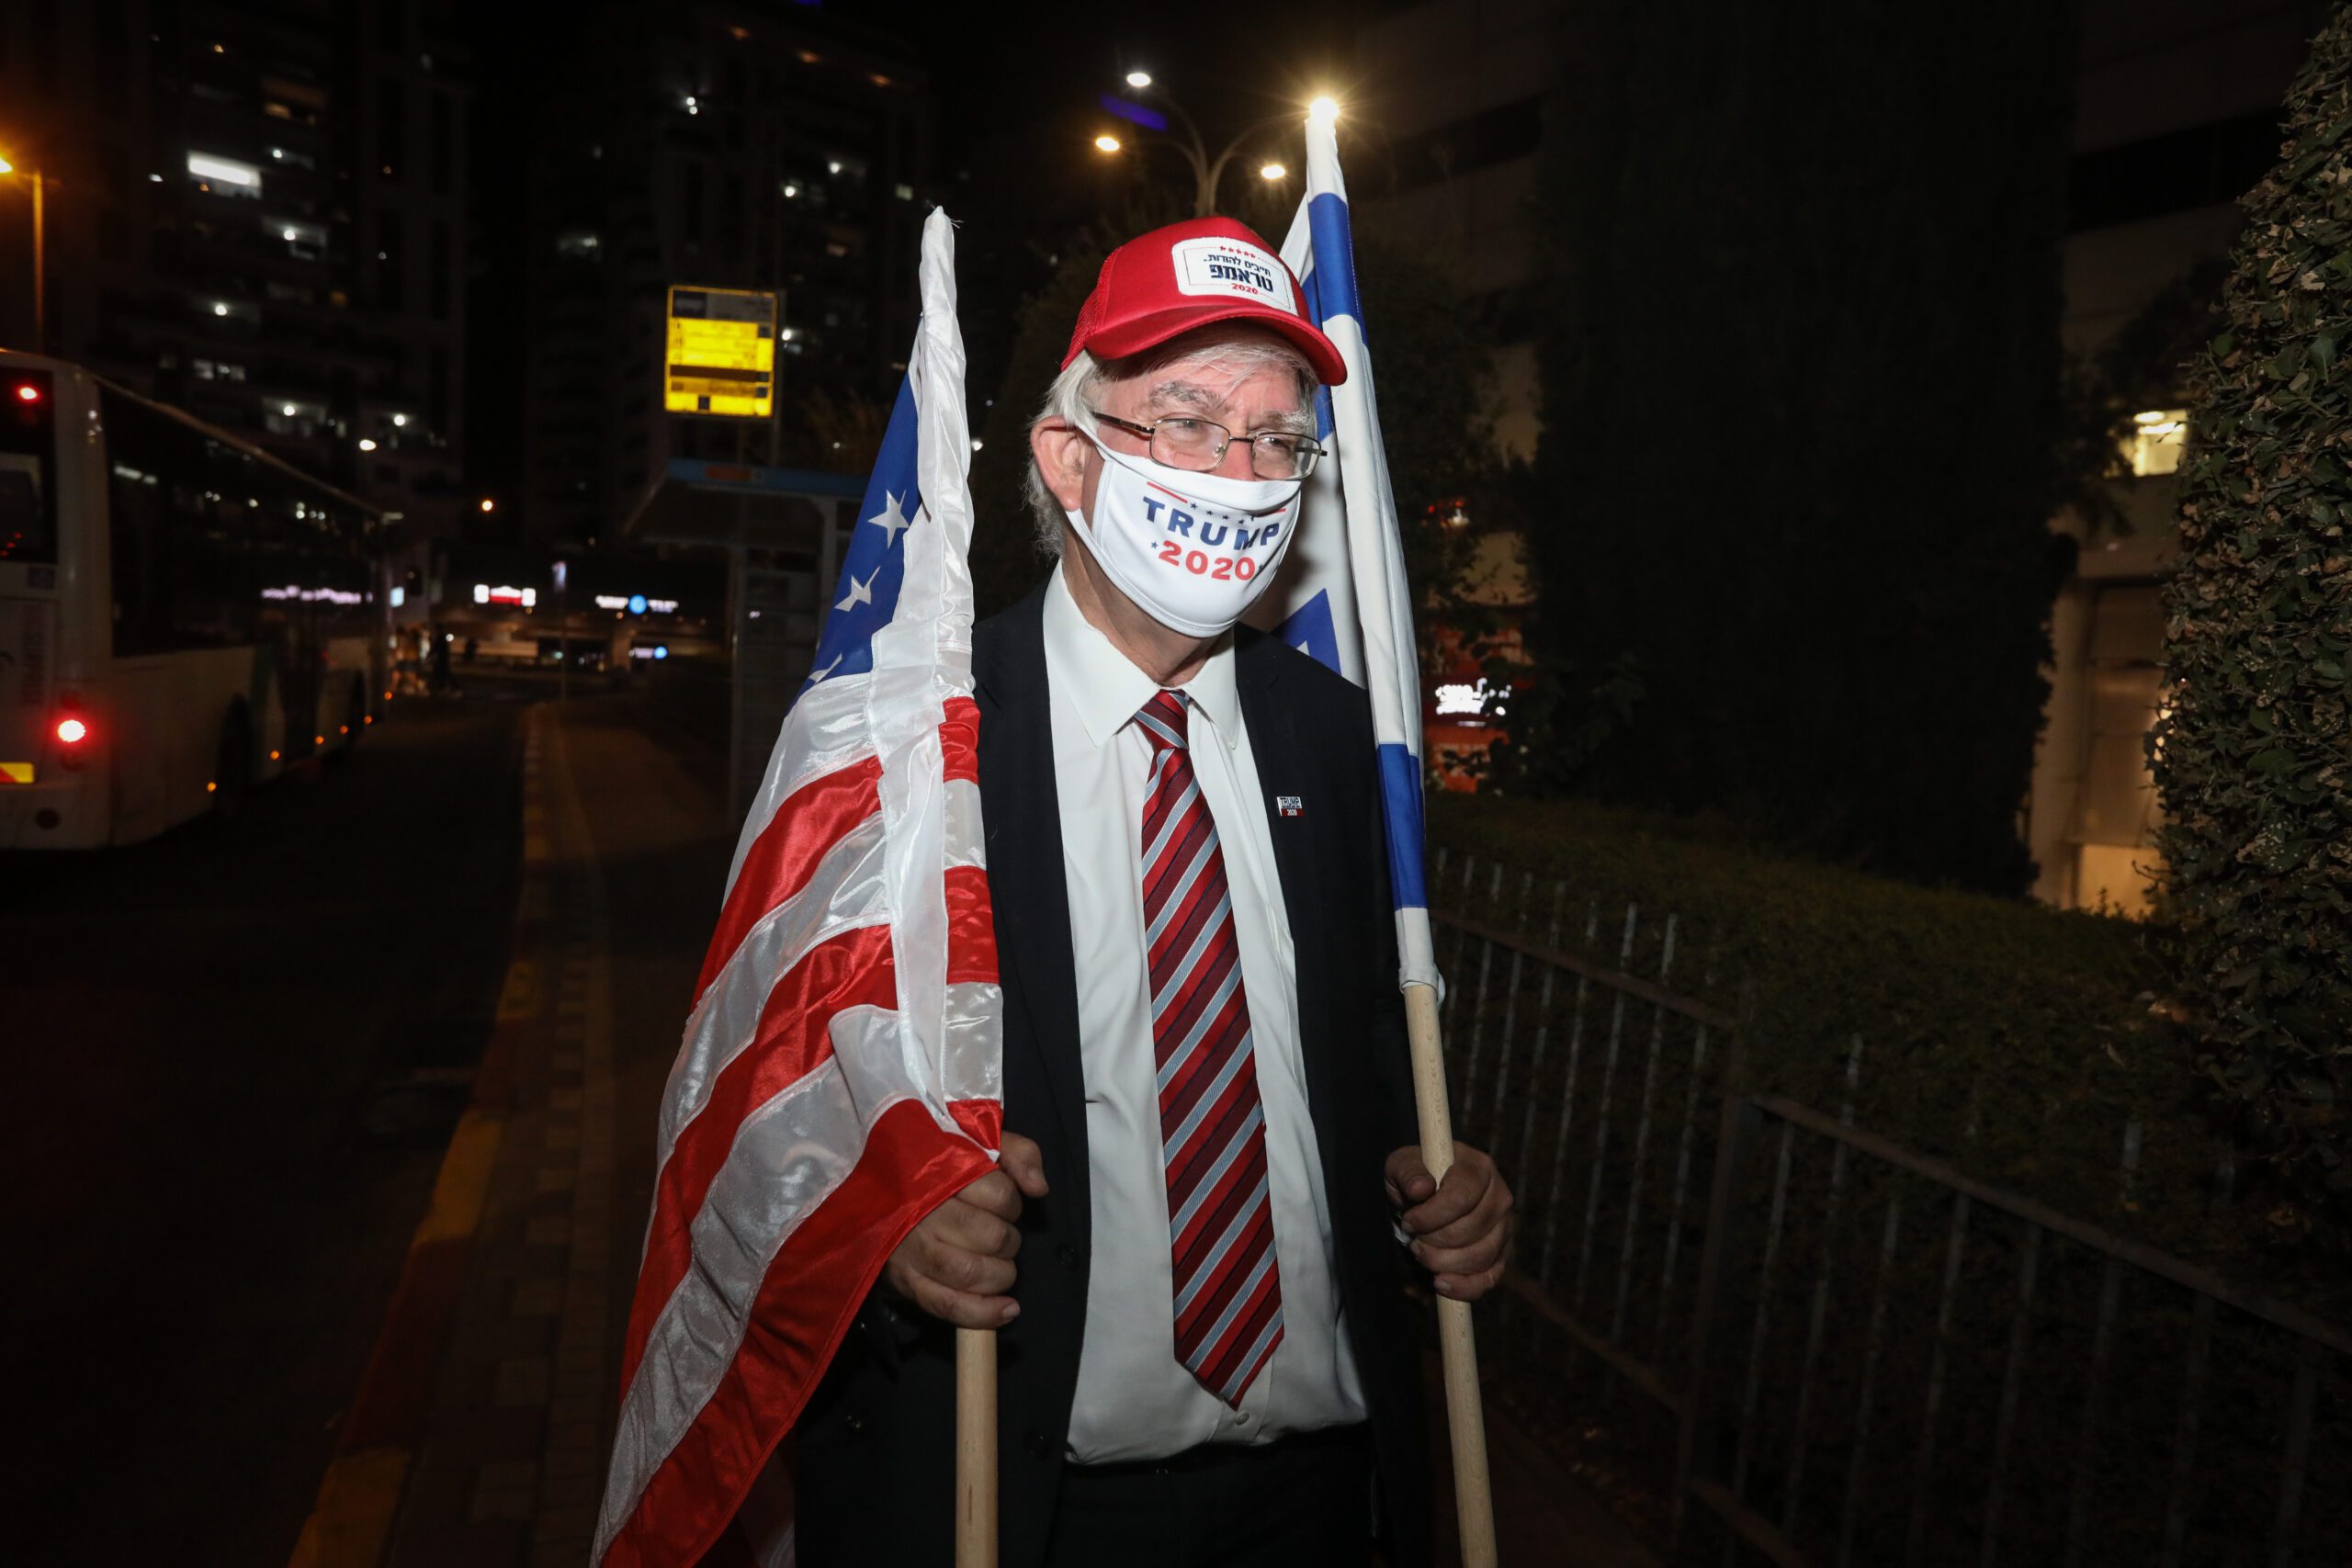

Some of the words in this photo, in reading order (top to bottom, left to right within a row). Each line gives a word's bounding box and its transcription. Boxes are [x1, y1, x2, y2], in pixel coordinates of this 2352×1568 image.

[1209, 265, 1273, 292] טראמפ
[1244, 260, 1272, 276] חייבים
[1231, 283, 1259, 295] 2020
[1143, 496, 1280, 551] TRUMP
[1159, 540, 1255, 581] 2020
[1280, 797, 1299, 806] TRUMP
